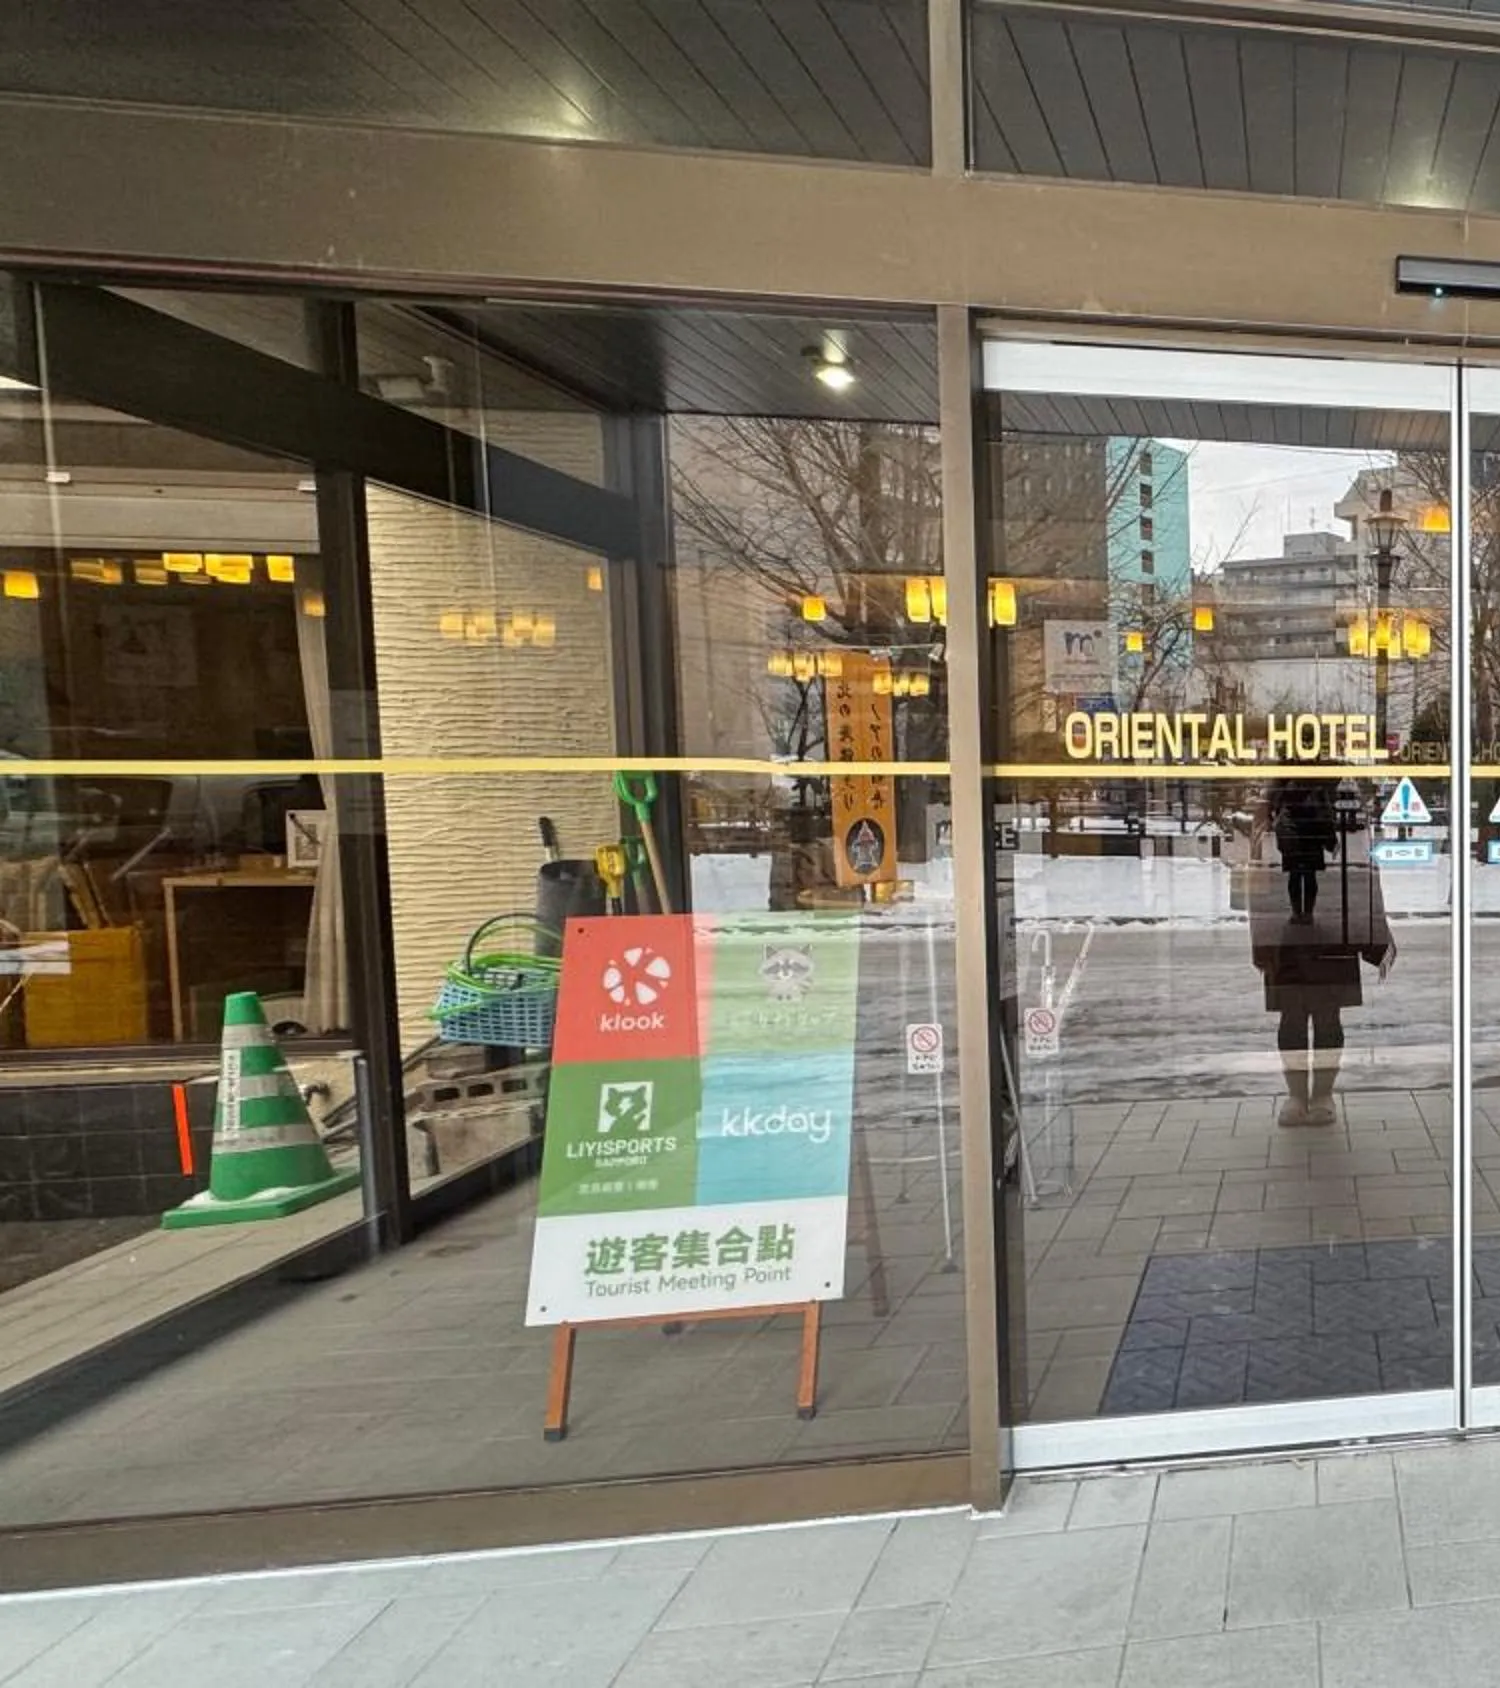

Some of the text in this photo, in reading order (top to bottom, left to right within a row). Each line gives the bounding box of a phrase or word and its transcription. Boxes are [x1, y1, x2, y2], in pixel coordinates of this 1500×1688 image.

[1064, 712, 1389, 760] ORIENTAL HOTEL
[600, 1011, 665, 1032] klook
[721, 1107, 832, 1144] kkday
[585, 1224, 796, 1275] 遊客集合點
[585, 1266, 791, 1298] Tourist Meeting Point
